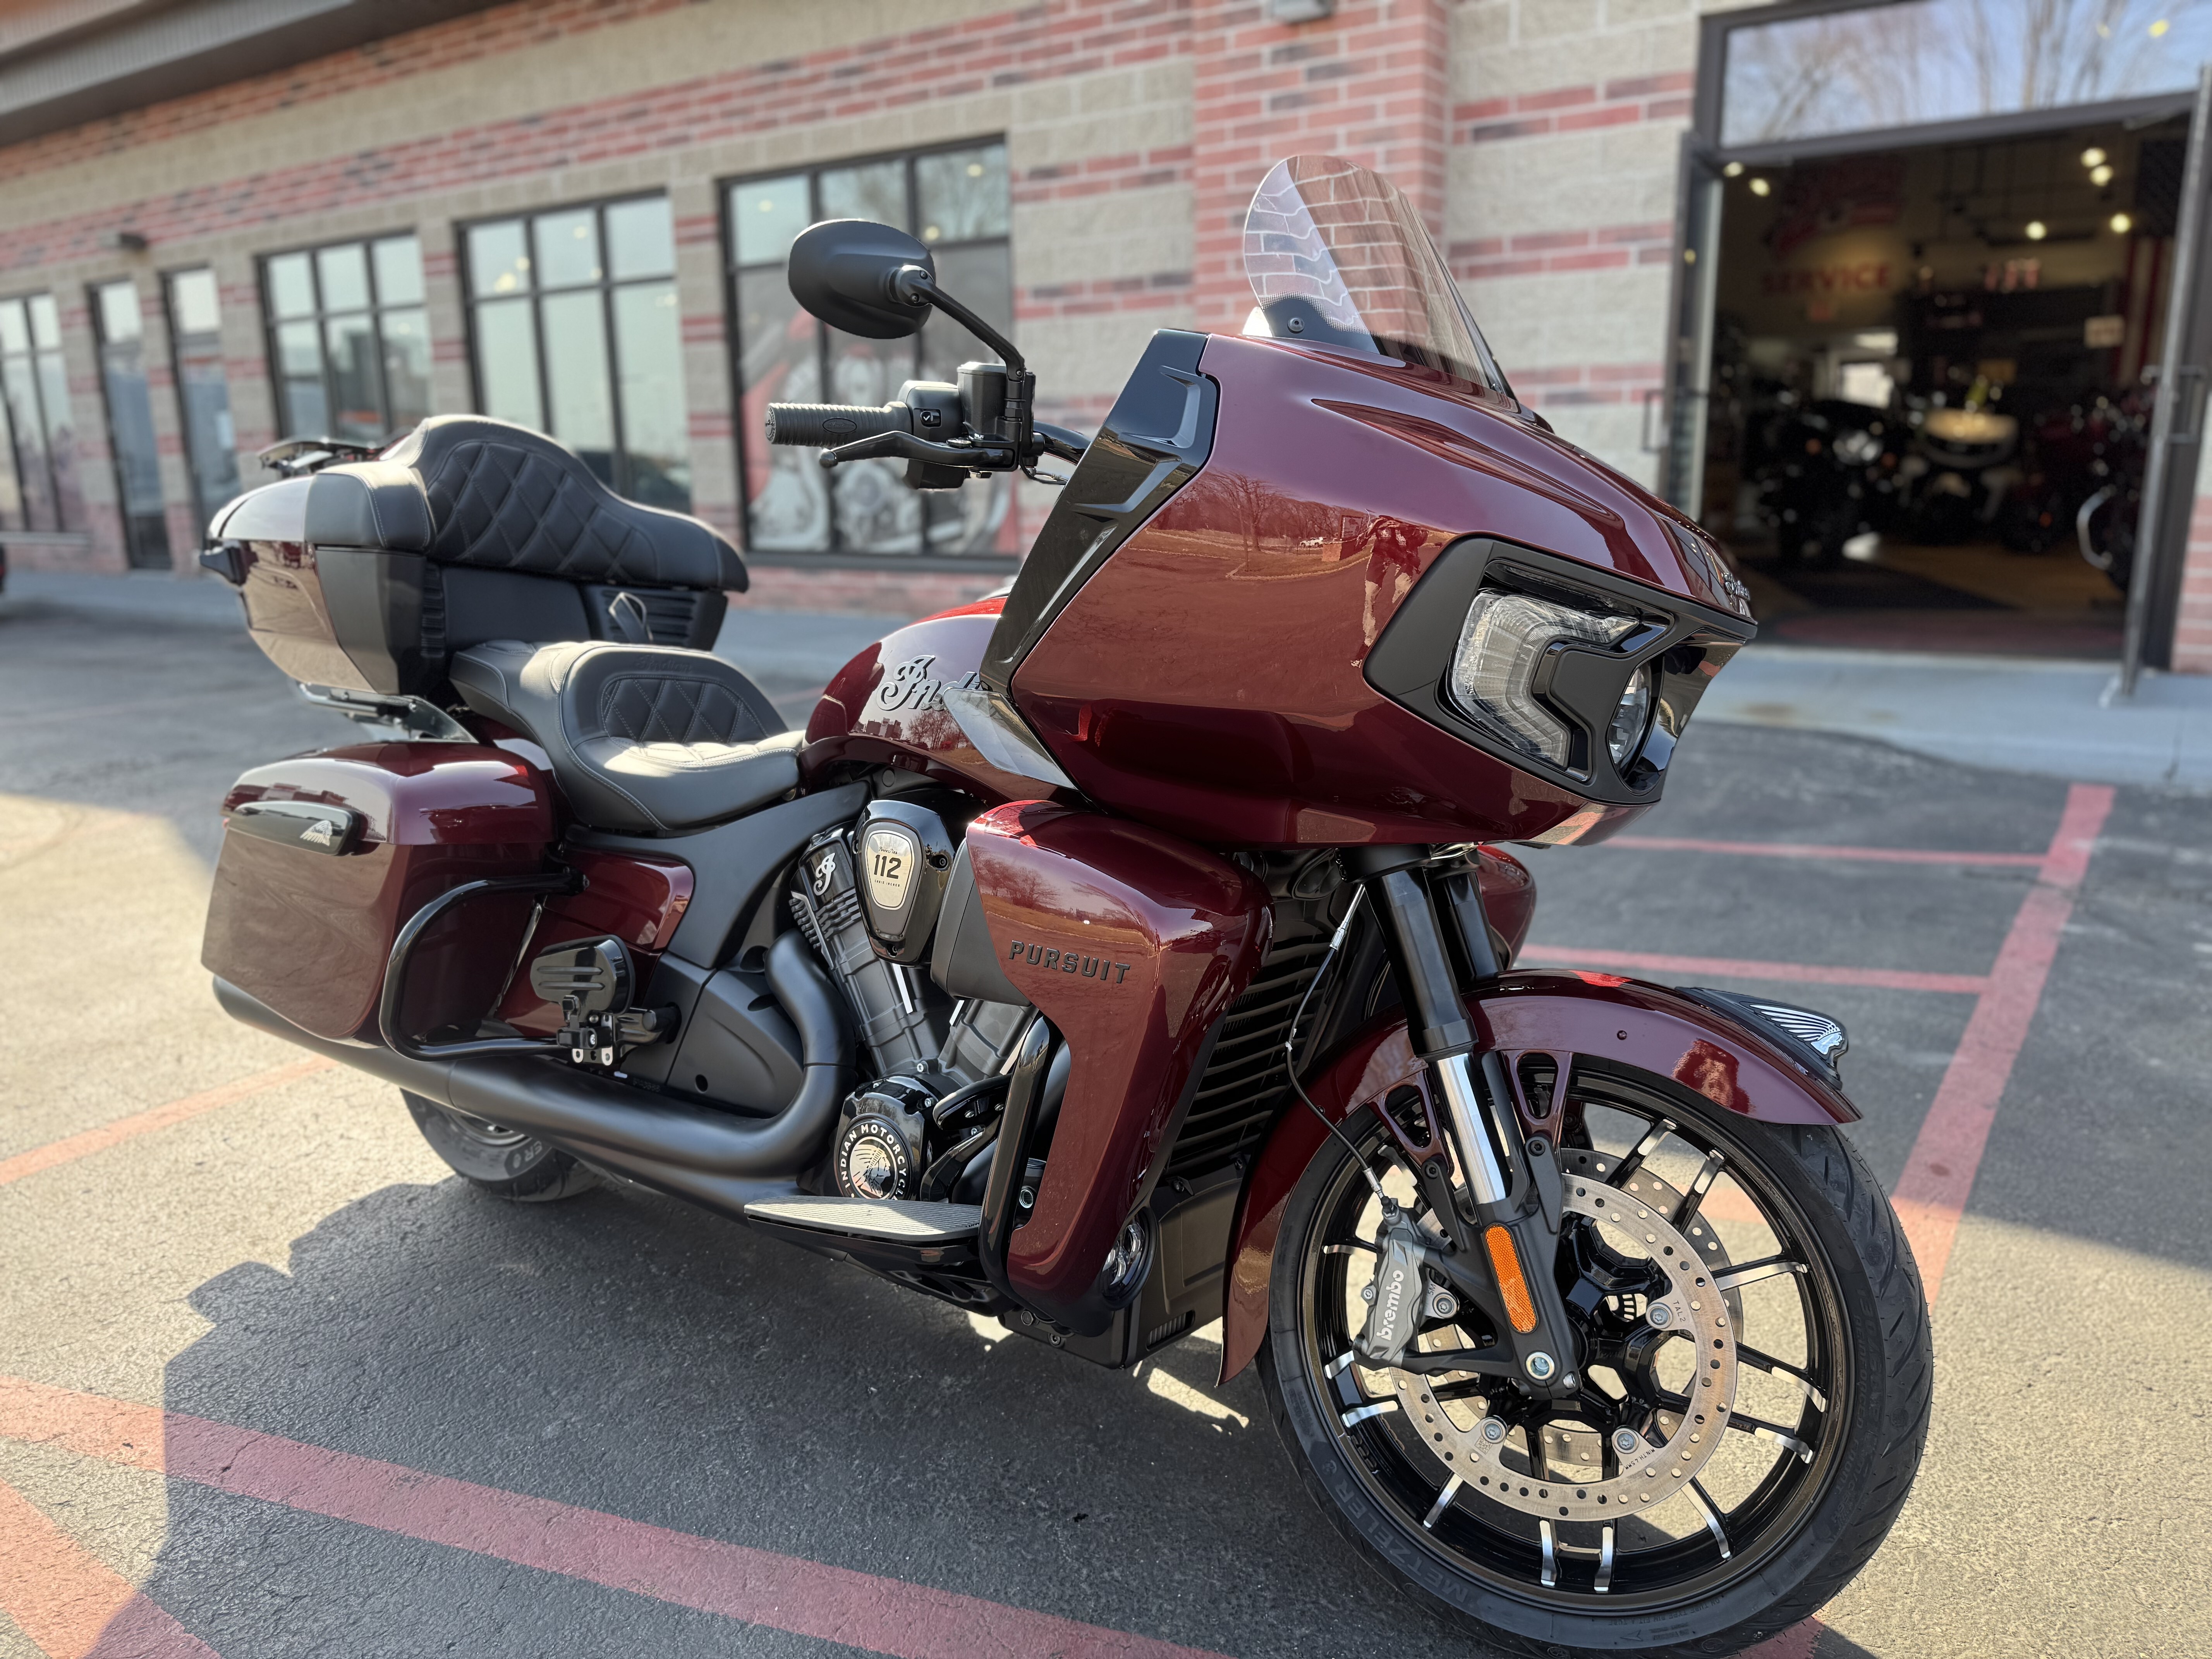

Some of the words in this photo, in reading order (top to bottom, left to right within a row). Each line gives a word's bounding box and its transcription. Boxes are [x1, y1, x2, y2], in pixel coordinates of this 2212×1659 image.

[874, 854, 902, 879] 112
[1008, 939, 1130, 984] PURSUIT
[840, 1130, 857, 1188] INDIAN
[1376, 1270, 1404, 1341] brembo
[1673, 1300, 1686, 1322] TAL2
[1853, 1314, 1867, 1429] REINFORCED
[1334, 1478, 1469, 1603] METZELER
